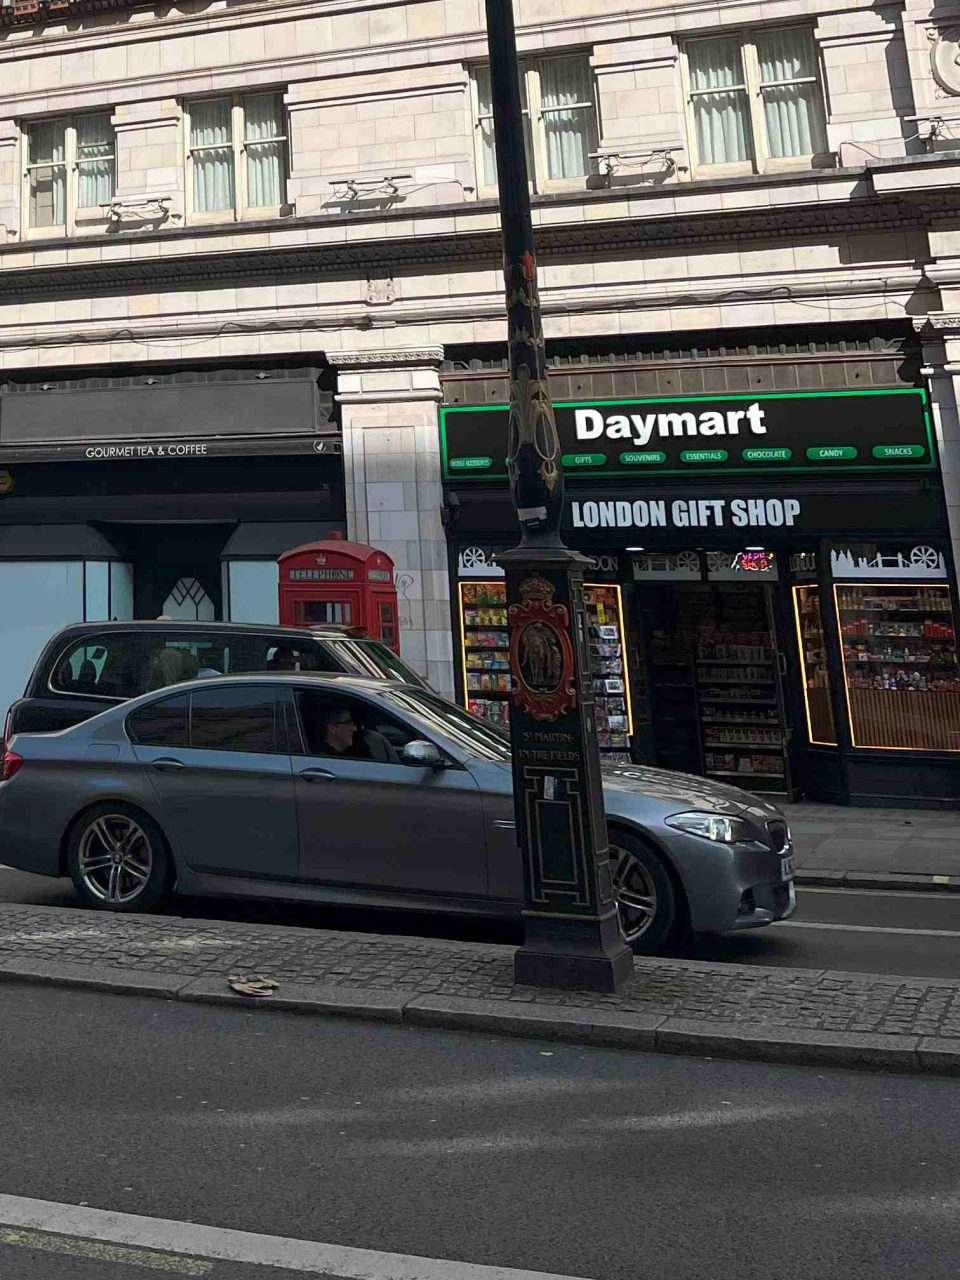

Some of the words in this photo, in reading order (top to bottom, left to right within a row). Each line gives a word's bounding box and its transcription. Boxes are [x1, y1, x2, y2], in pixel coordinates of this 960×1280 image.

[575, 402, 767, 446] Daymart
[85, 446, 135, 458] GOURMET
[137, 446, 155, 456] TEA
[157, 446, 165, 456] &
[167, 444, 207, 456] COFFEE
[747, 449, 787, 459] CHOCOLATE
[818, 449, 844, 458] CANDY
[884, 447, 913, 456] SNACKS
[574, 455, 593, 464] GIFTS
[624, 453, 661, 462] SOUVENIRS
[685, 452, 722, 461] ESSENTIALS
[571, 500, 667, 528] LONDON
[671, 499, 725, 528] GIFT
[731, 498, 801, 528] SHOP
[290, 568, 354, 580] TELEPHONE
